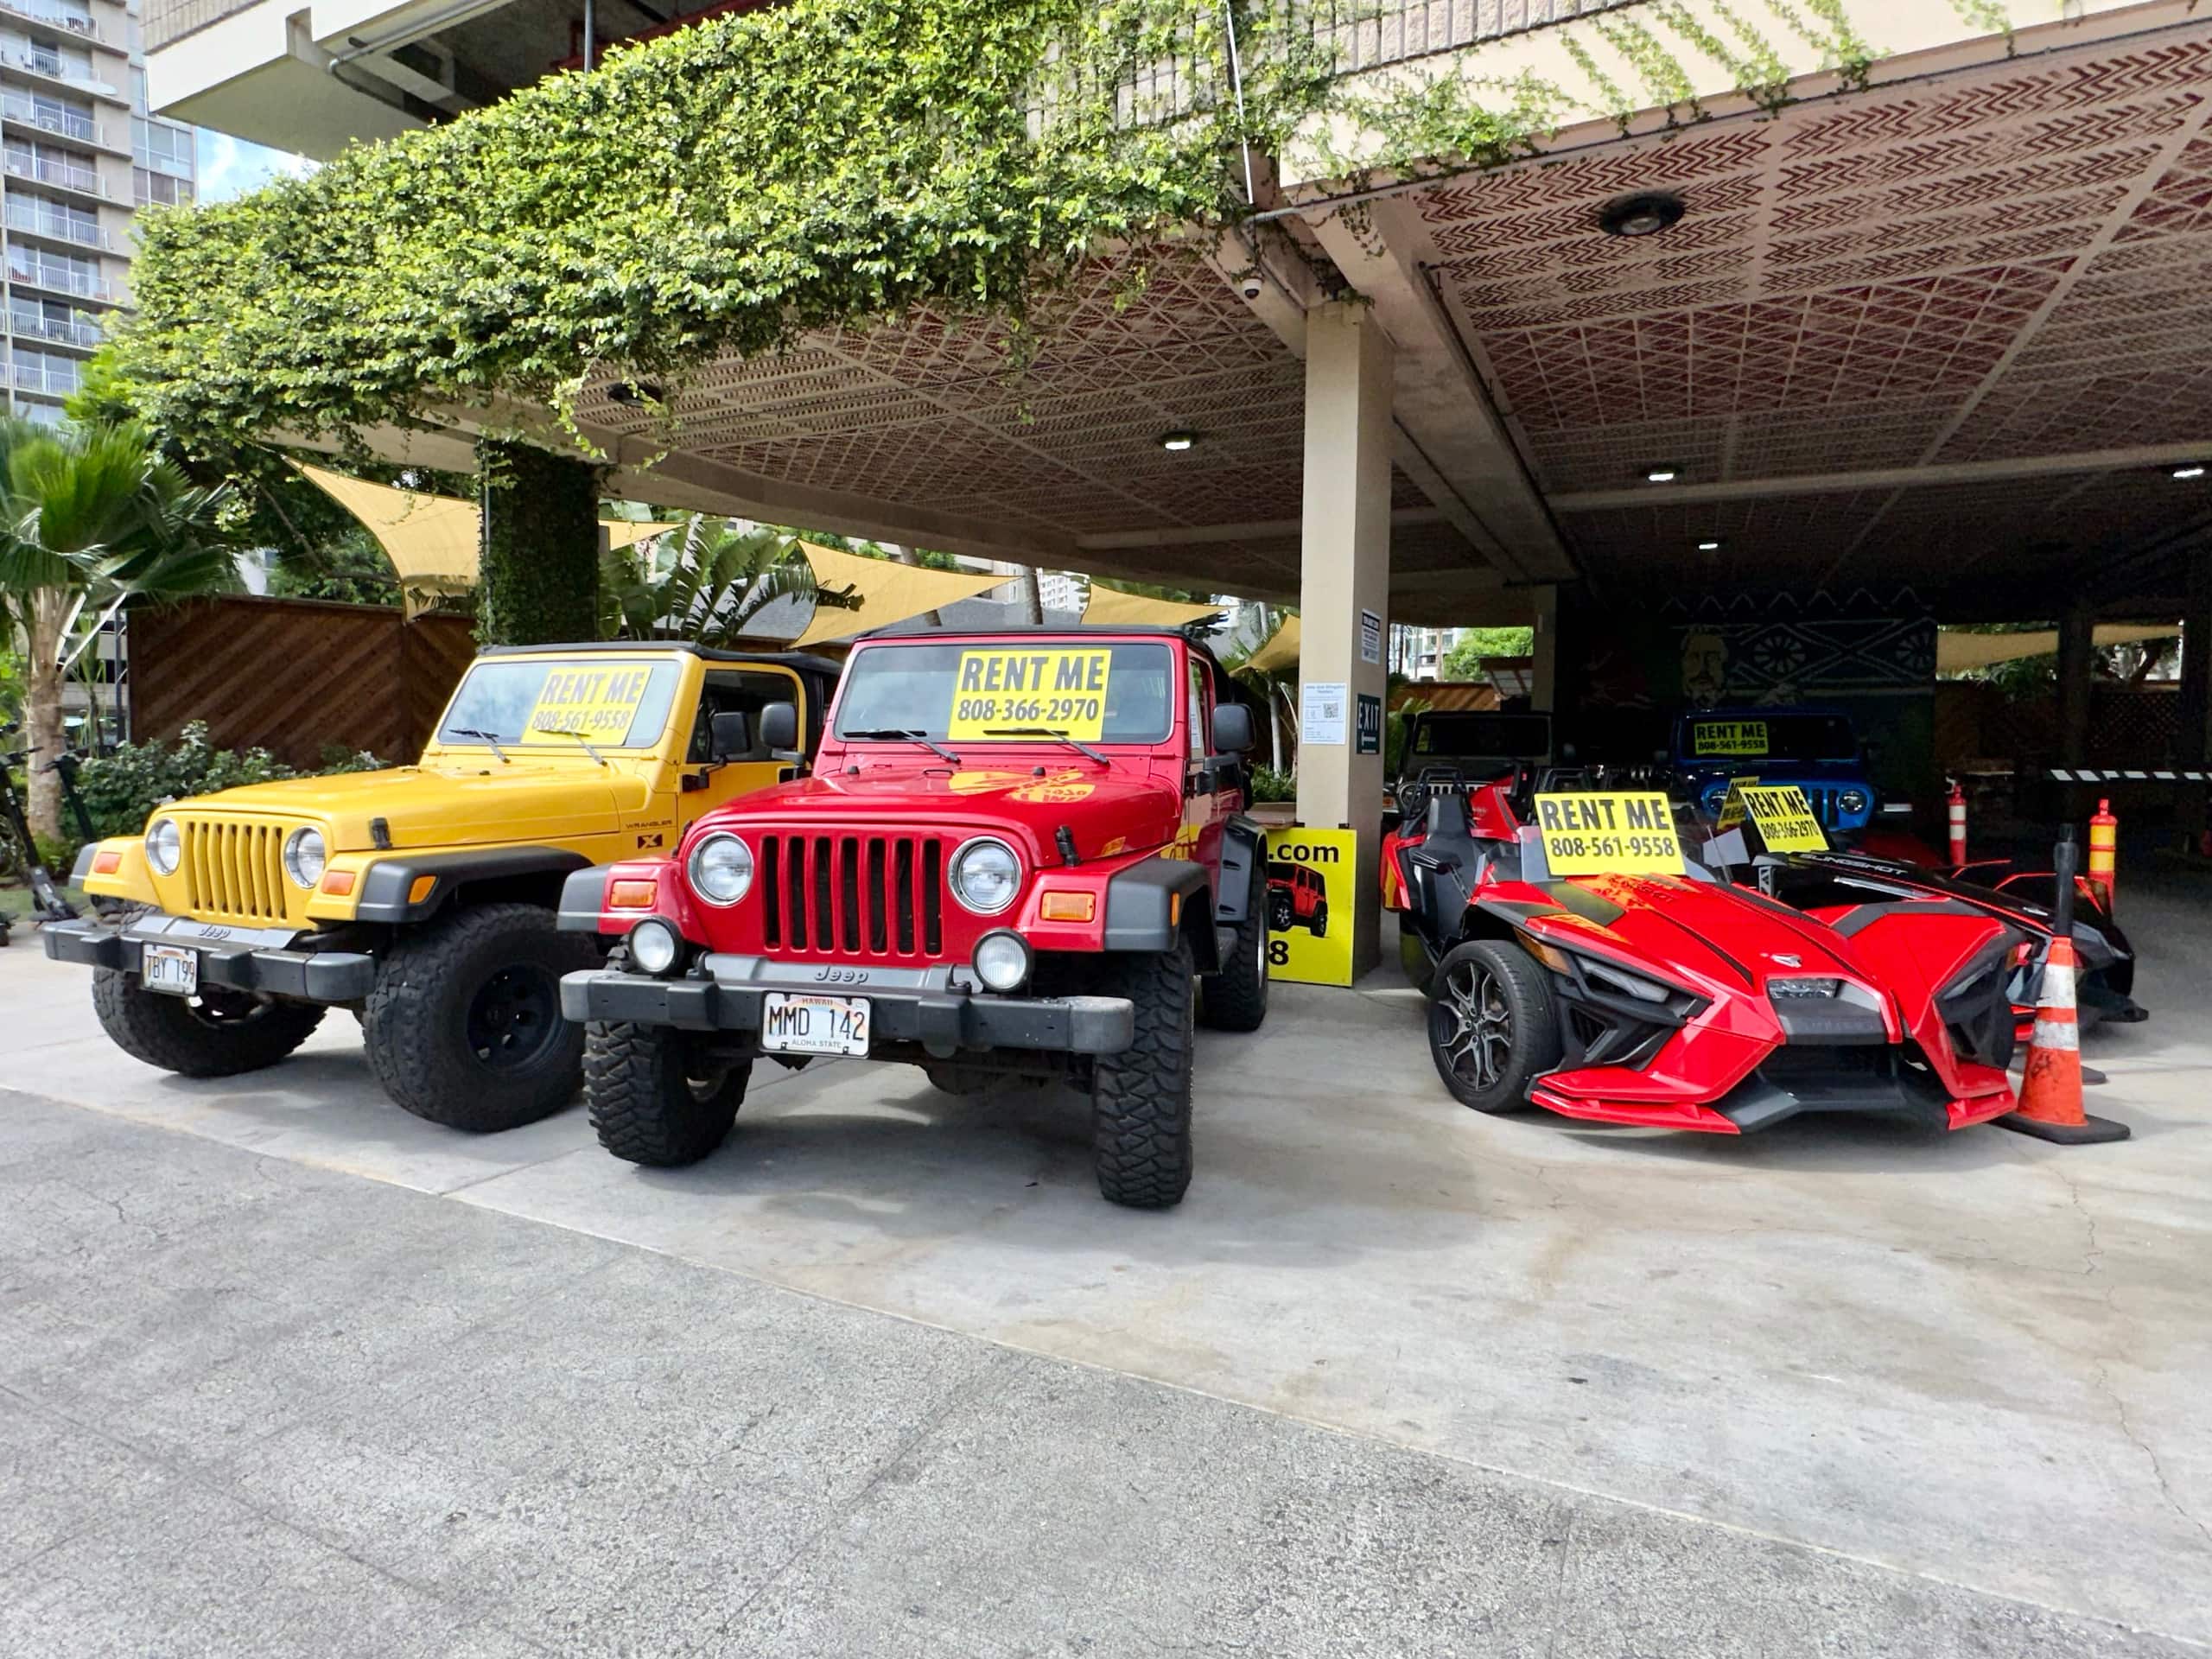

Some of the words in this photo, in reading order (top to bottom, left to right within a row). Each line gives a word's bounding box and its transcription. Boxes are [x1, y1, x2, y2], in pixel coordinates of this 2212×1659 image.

[961, 656, 1050, 692] RENT
[1053, 656, 1104, 691] ME
[539, 673, 608, 705] RENT
[602, 671, 645, 704] ME
[531, 709, 632, 731] 808-561-9558
[957, 698, 1100, 722] 808-366-2970
[1357, 701, 1380, 731] EXIT
[1696, 724, 1737, 741] RENT
[1741, 722, 1765, 739] ME
[1540, 798, 1617, 831] RENT
[1624, 798, 1670, 830] ME
[1744, 791, 1787, 819] RENT
[1781, 790, 1810, 817] ME
[626, 819, 672, 830] WRANGLER
[1760, 819, 1820, 841] 808-366-2970
[1550, 836, 1675, 857] 808-561-9558
[1799, 853, 1909, 875] SLINGSHOT
[198, 924, 232, 940] Jeep
[145, 954, 168, 980] TBY
[176, 959, 195, 983] 199
[814, 965, 869, 985] Jeep
[802, 997, 834, 1007] HAWAII
[768, 1005, 810, 1036] MMD
[829, 1008, 865, 1041] 142
[791, 1039, 817, 1047] ALOHA
